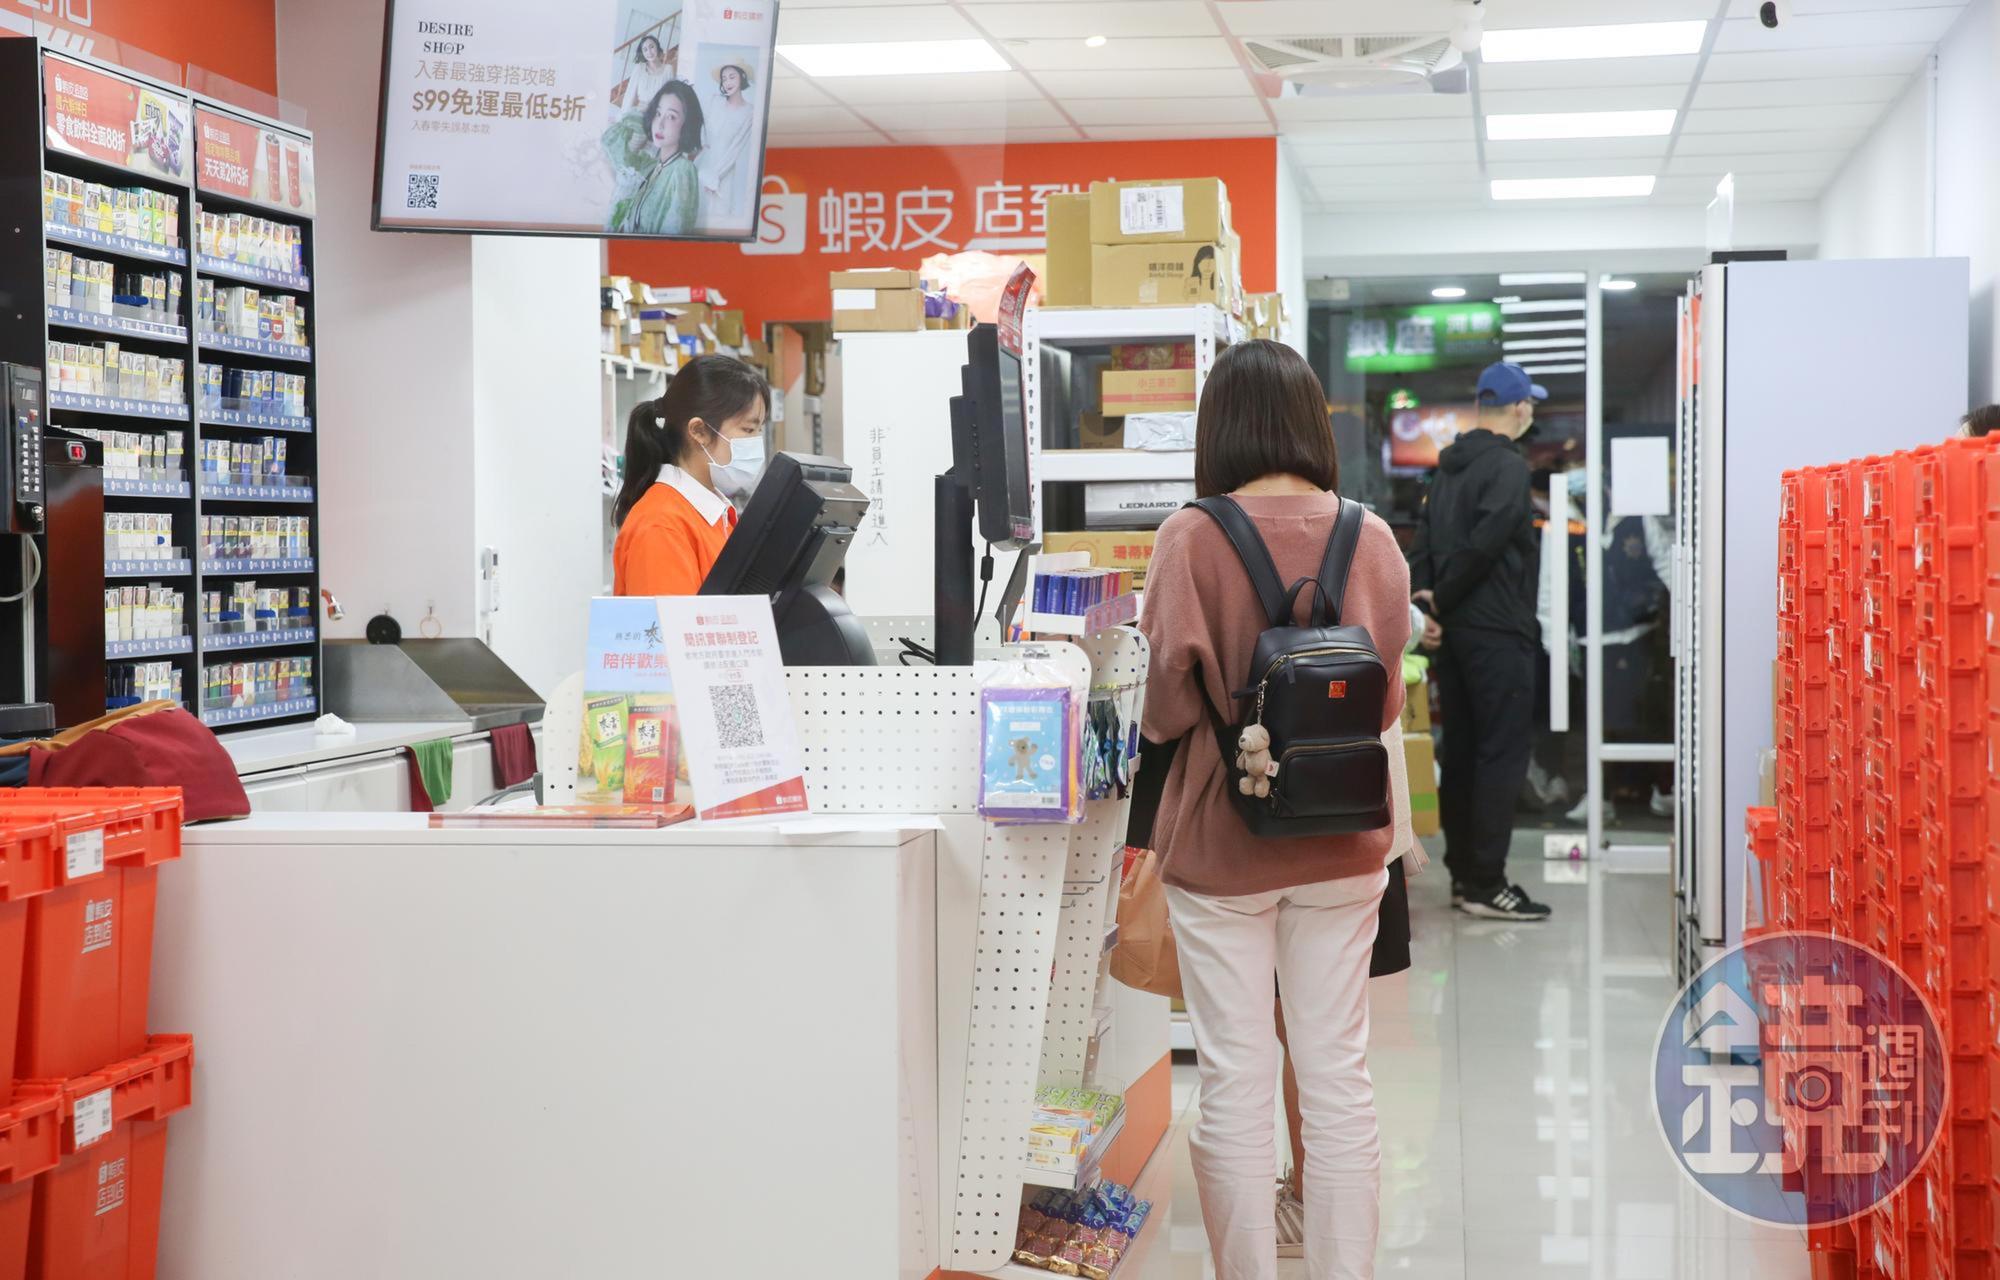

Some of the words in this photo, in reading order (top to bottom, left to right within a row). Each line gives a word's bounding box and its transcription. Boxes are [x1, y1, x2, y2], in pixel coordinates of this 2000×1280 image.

[418, 21, 474, 37] DESIRE
[423, 40, 465, 55] SHOP
[414, 59, 556, 87] 入春最強穿搭攻略
[412, 87, 586, 122] $99免運最低5折
[819, 185, 960, 254] 蝦皮
[869, 425, 889, 546] 非員工請勿進入
[1119, 501, 1178, 510] LEONARDO
[684, 630, 760, 648] 簡訊實聯制登記
